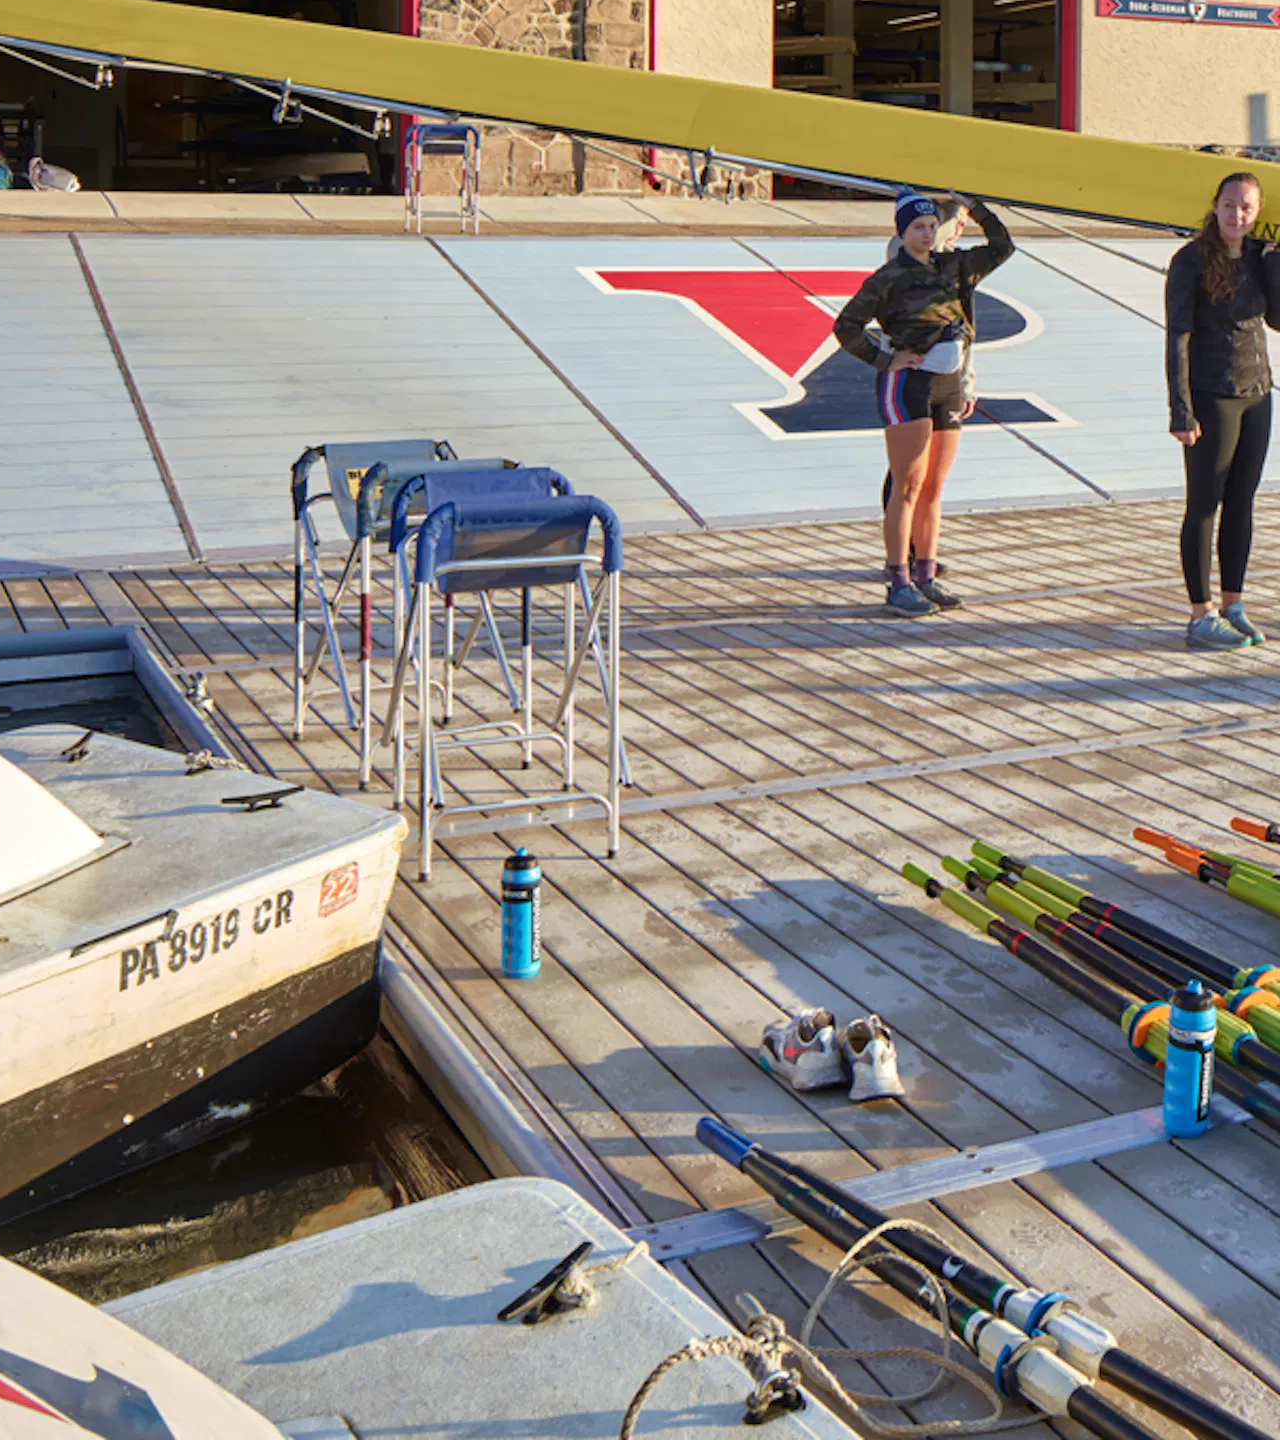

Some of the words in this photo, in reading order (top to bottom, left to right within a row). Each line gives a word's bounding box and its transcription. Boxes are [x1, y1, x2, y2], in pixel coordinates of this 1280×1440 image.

[119, 940, 161, 992] PA
[167, 908, 241, 973] 8919
[252, 888, 295, 935] CR
